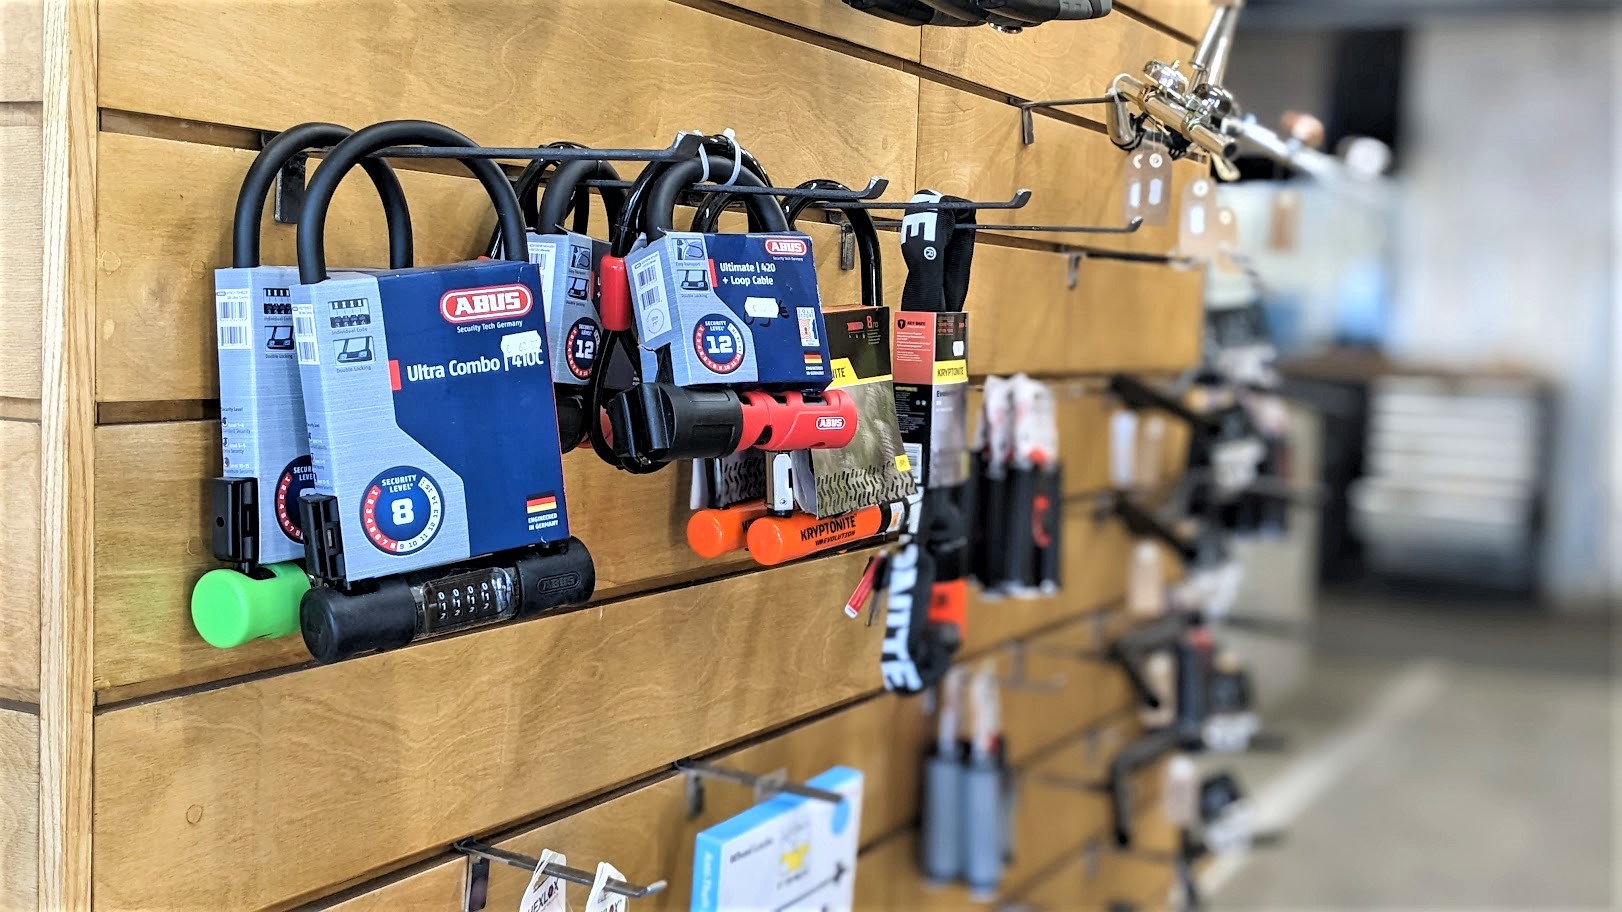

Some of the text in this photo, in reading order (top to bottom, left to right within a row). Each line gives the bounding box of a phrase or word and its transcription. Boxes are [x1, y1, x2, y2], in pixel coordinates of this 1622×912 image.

[772, 242, 802, 252] ABUS
[720, 262, 776, 272] Ultimate 420
[730, 276, 750, 286] Loop
[752, 276, 774, 285] Cable
[455, 292, 521, 316] ABUS
[456, 320, 523, 333] Security Tech Germany
[576, 340, 594, 360] 12
[706, 335, 734, 354] 12
[406, 364, 445, 382] Ultra
[449, 356, 500, 376] Combo
[819, 418, 844, 428] ABUS
[382, 474, 416, 486] SECURITY
[390, 484, 412, 493] LEVEL
[391, 498, 414, 526] 8
[800, 516, 856, 542] KRYPTONITE
[822, 530, 856, 544] EVOLUTION
[543, 576, 575, 590] ABUS
